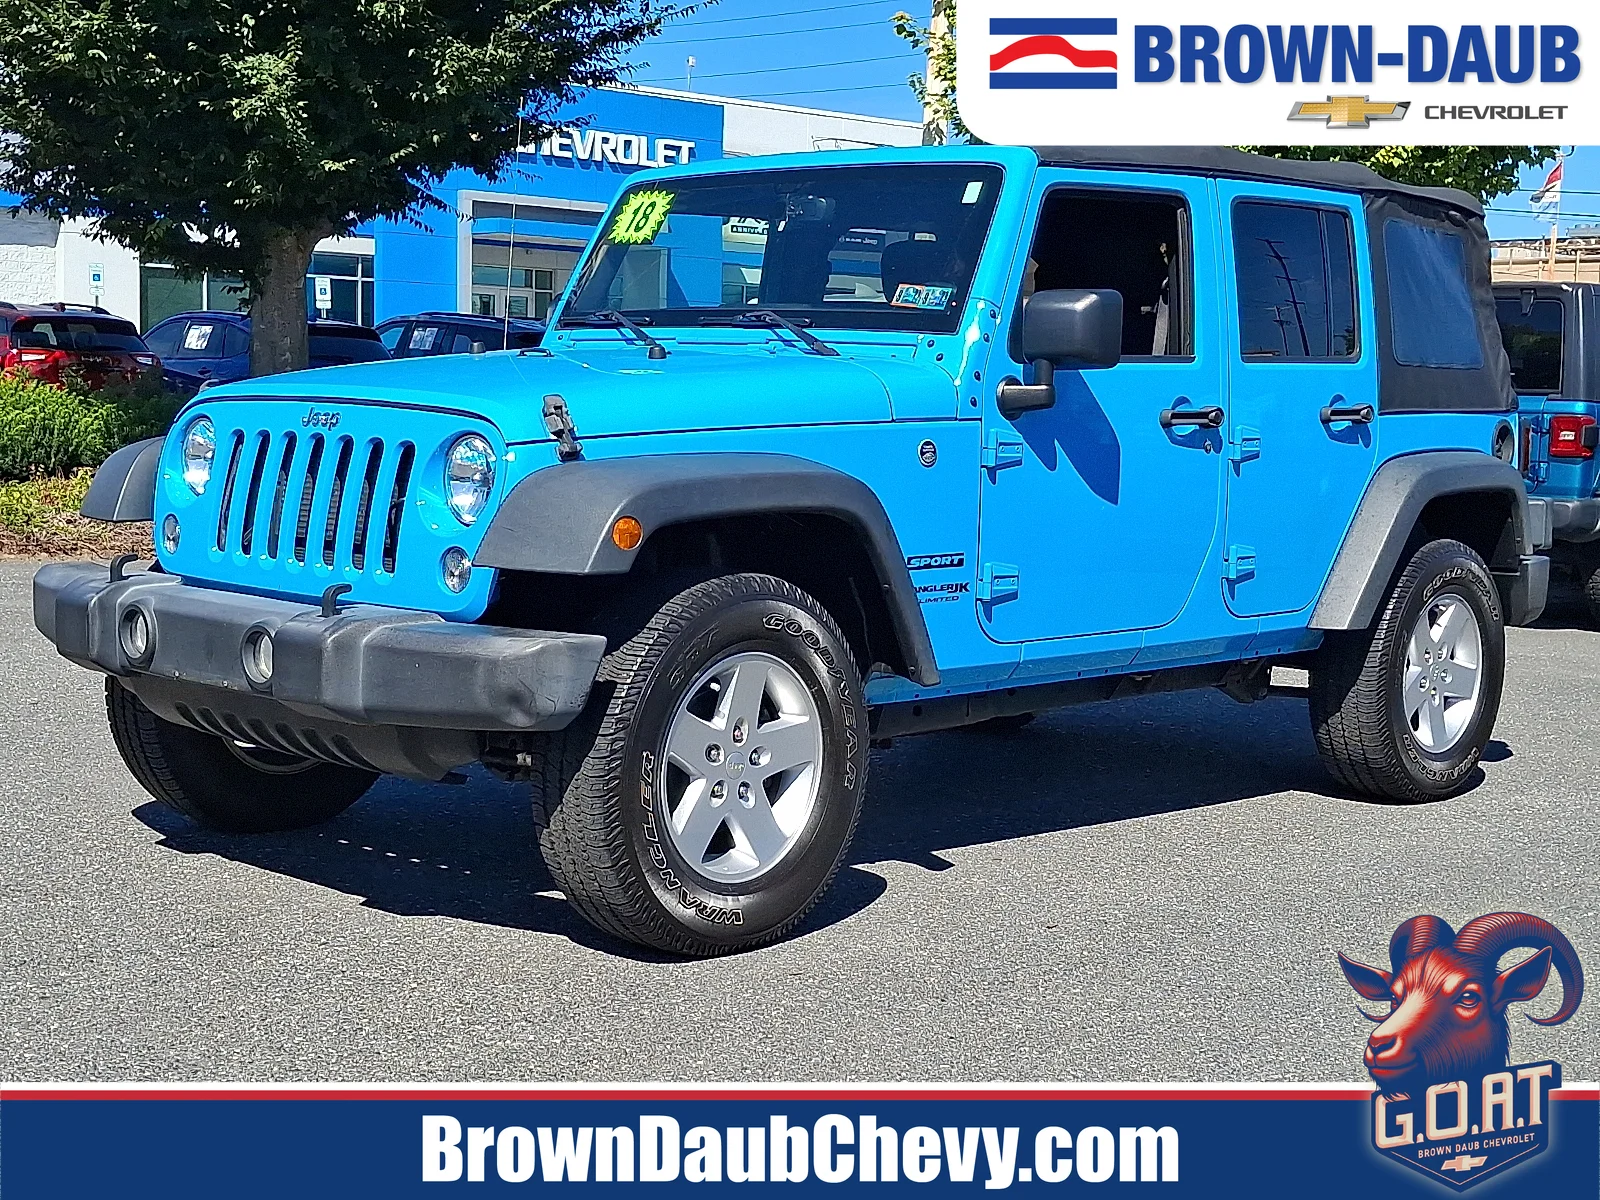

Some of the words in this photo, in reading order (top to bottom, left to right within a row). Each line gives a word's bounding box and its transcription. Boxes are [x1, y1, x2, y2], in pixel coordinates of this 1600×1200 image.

[516, 125, 695, 168] EVROLET
[625, 201, 656, 232] 18
[301, 406, 342, 431] Jeep
[910, 555, 960, 567] SPORT
[914, 584, 954, 593] ANGLER
[919, 595, 959, 603] LIMITED
[1423, 566, 1498, 622] GOODYEAR
[762, 612, 859, 790] GOODYEAR
[1402, 733, 1480, 783] WRANGLER
[640, 751, 744, 925] WRANGLER
